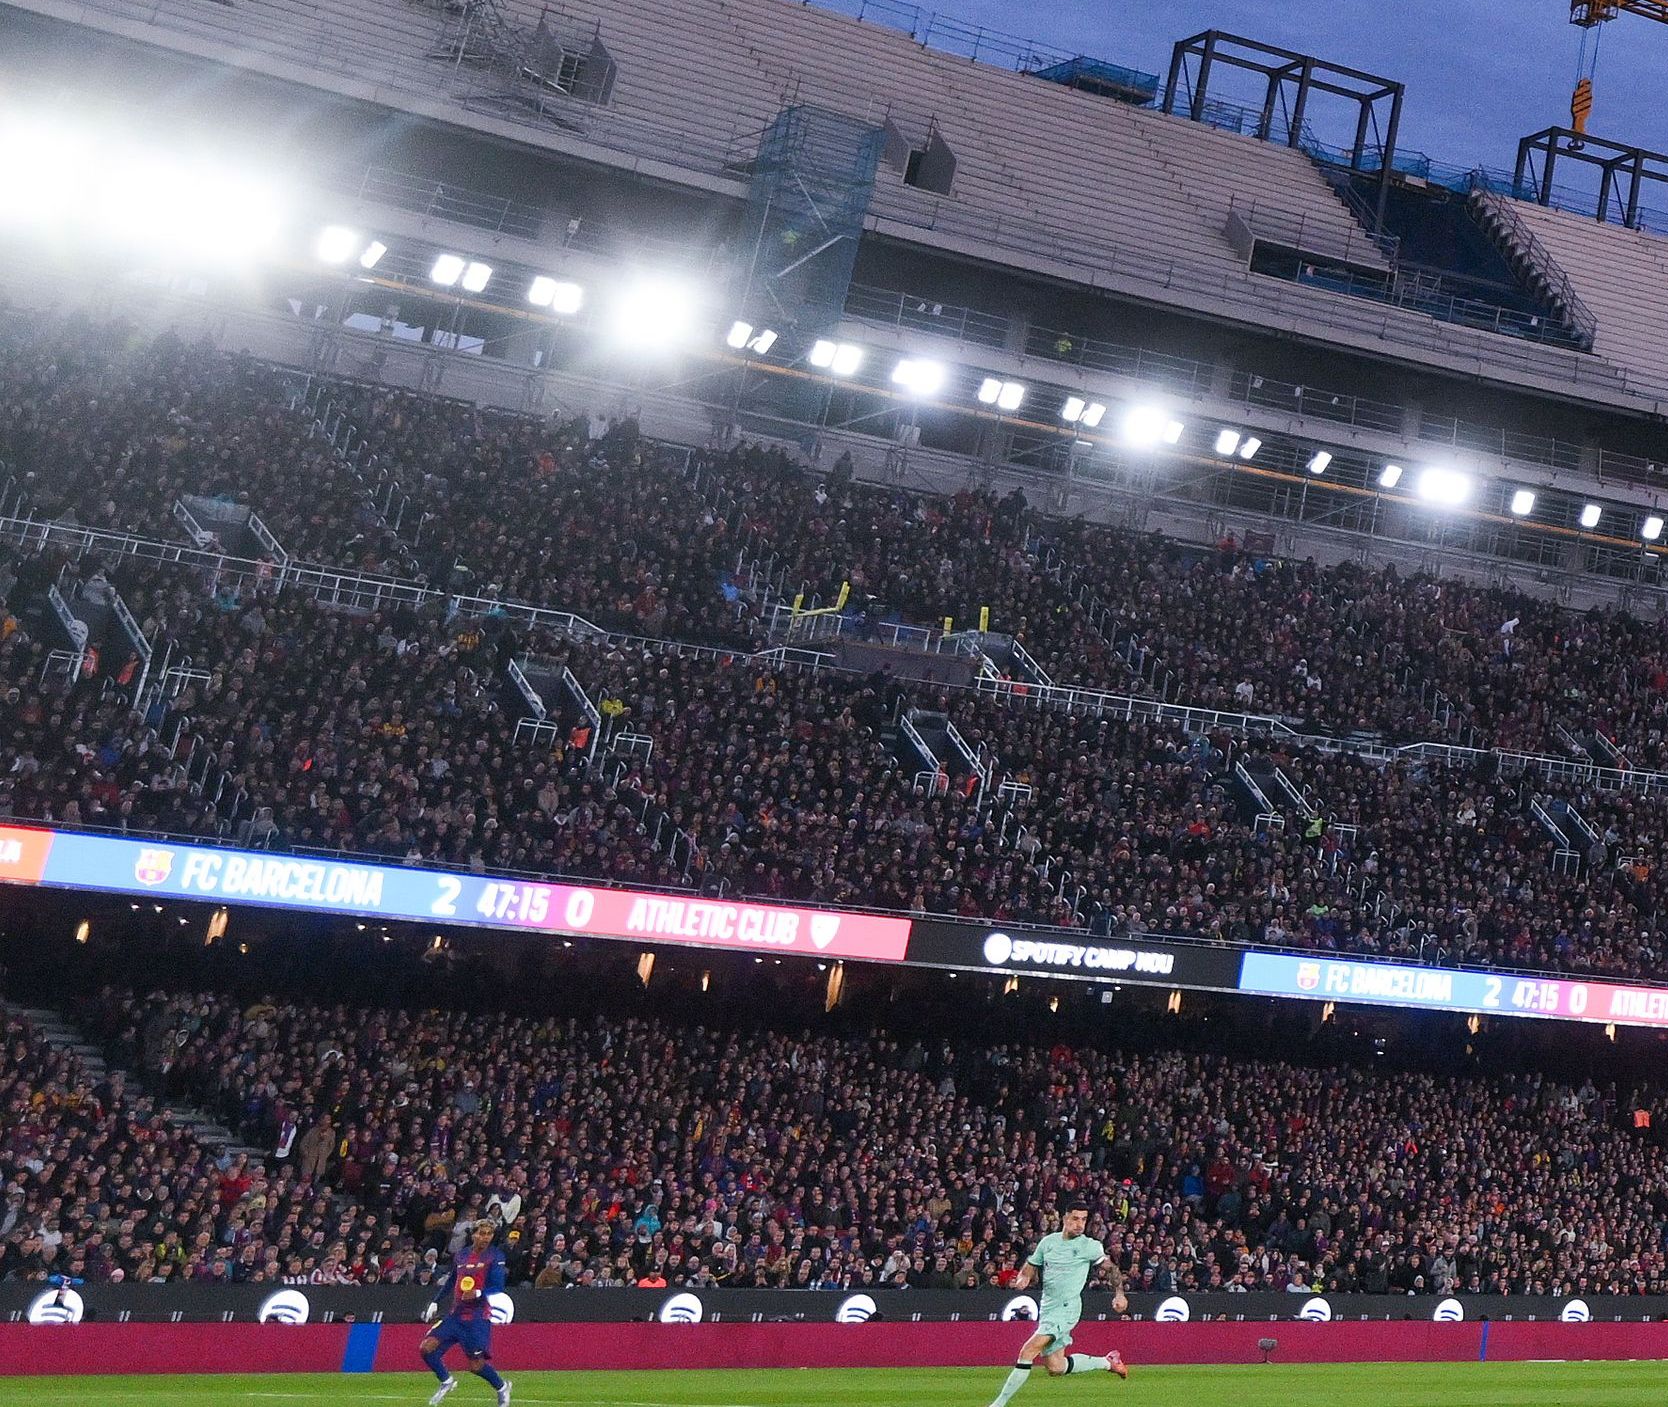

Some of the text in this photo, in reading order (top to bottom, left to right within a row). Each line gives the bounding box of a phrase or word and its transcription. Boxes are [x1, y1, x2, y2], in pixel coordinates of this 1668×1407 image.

[181, 851, 384, 906] FC BARCELONA
[431, 876, 462, 915] 2
[476, 881, 551, 923] 47:15
[565, 891, 595, 928] 0
[627, 897, 799, 945] ATHLETIC CLUB
[1011, 940, 1174, 974] SPOTIFY CAMP NOU
[1324, 963, 1450, 1002] FC BARCELONA
[1482, 976, 1502, 1007] 2
[1512, 980, 1560, 1011] 47:15
[1568, 984, 1587, 1014] 0
